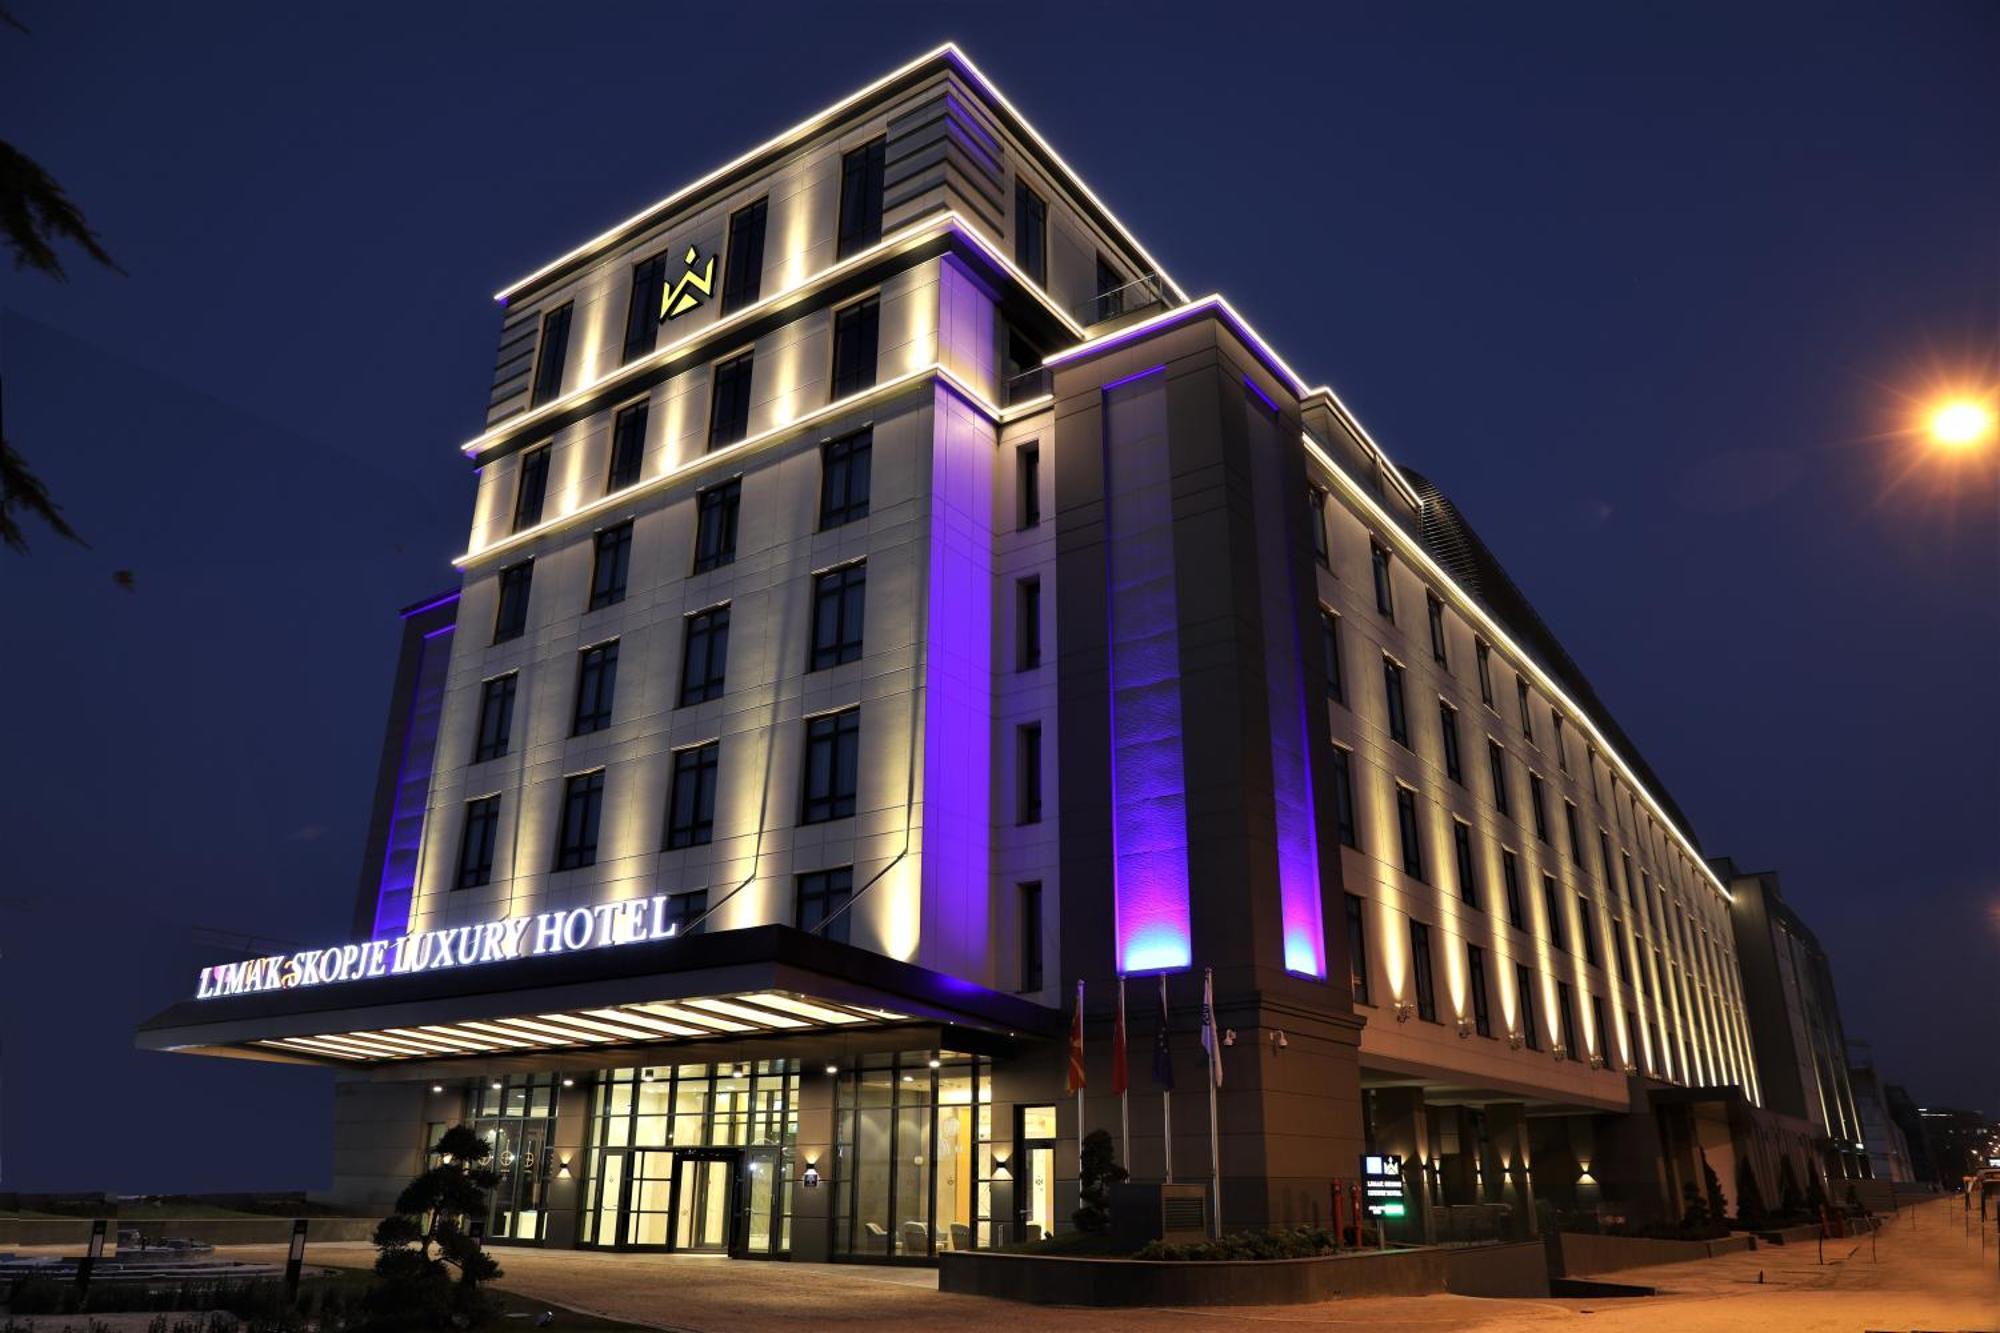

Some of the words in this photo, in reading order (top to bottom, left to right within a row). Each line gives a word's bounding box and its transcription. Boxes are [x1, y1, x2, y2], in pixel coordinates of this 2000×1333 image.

[197, 956, 284, 999] LIMAK
[289, 939, 388, 988] SKOPJE
[391, 917, 530, 973] LUXURY
[533, 896, 677, 954] HOTEL
